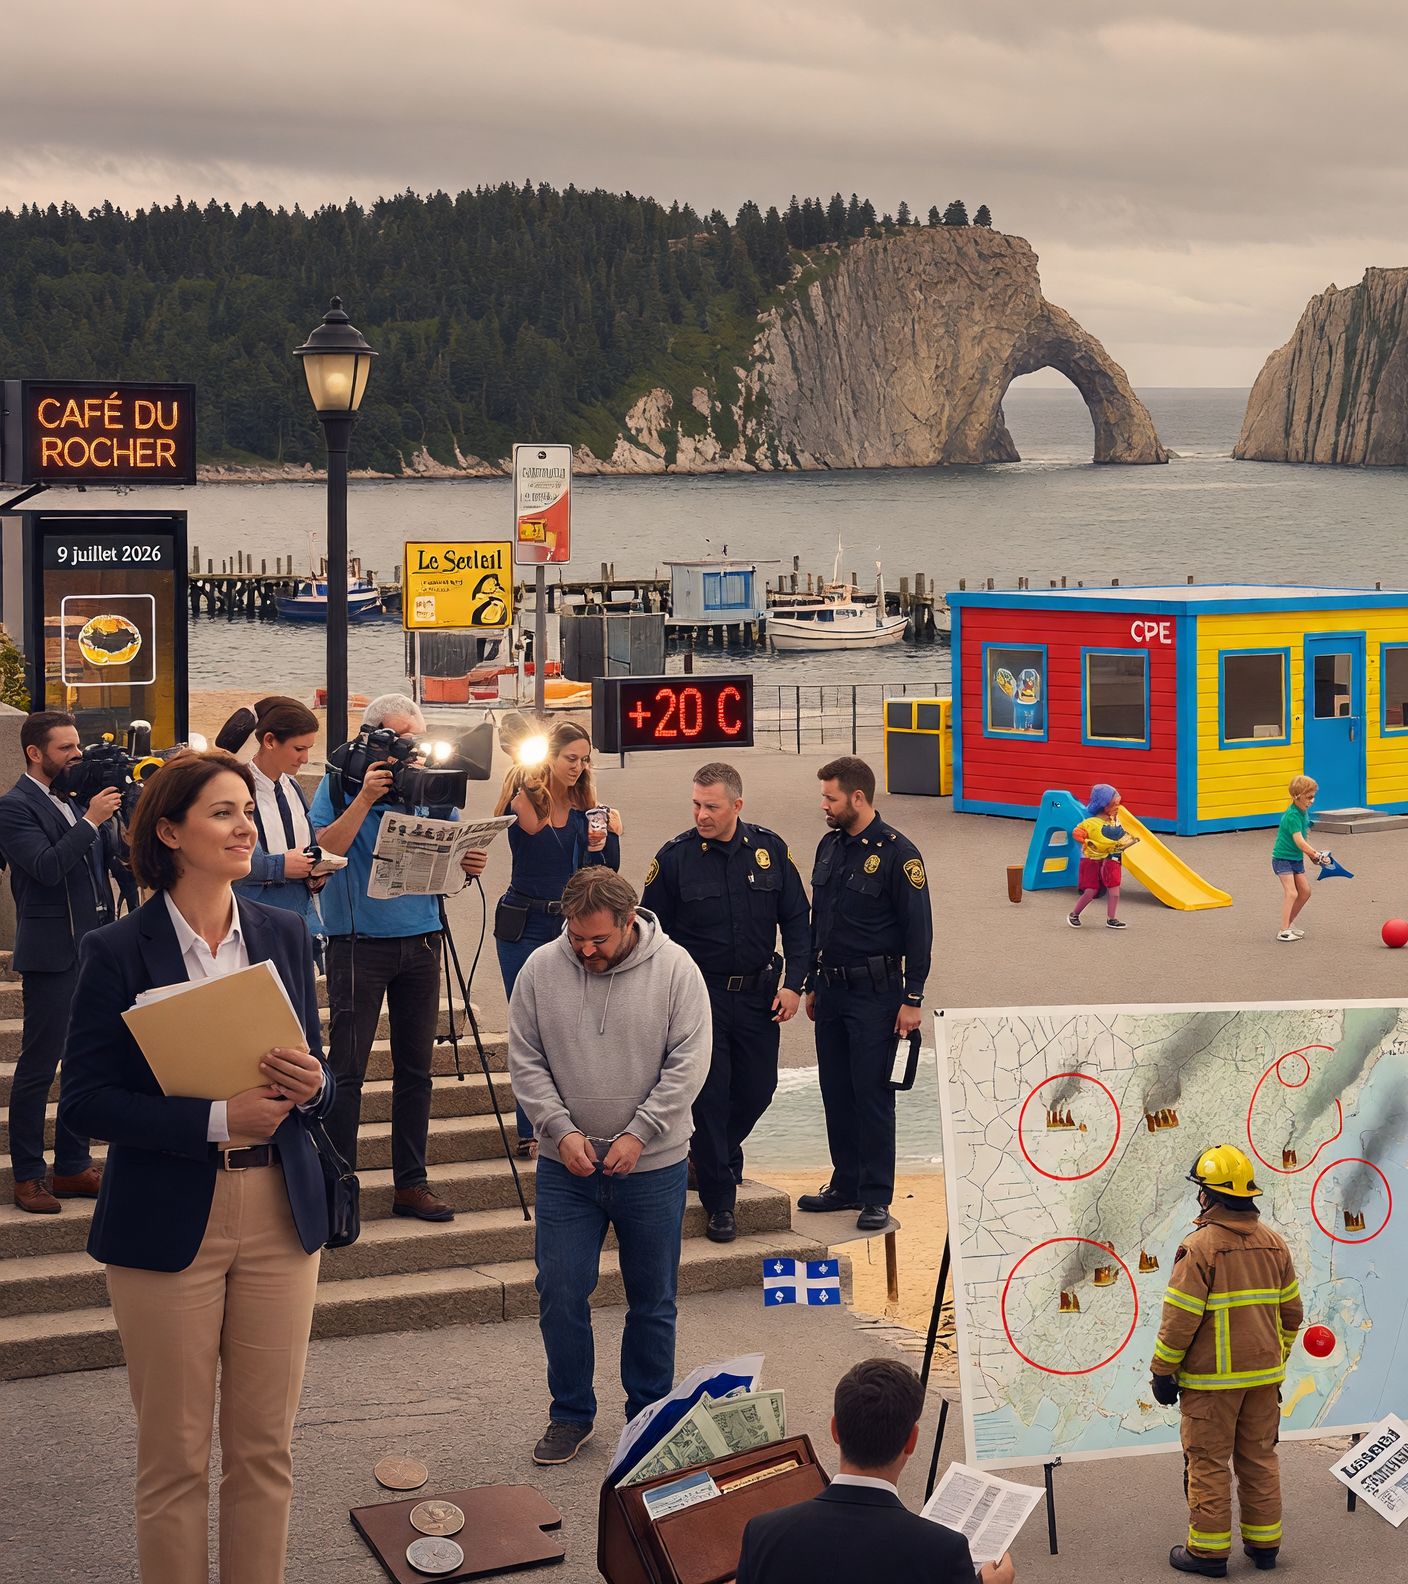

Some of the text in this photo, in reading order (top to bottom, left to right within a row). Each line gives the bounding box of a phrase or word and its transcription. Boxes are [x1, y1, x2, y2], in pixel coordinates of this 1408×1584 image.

[38, 392, 178, 430] CAFÉ DU
[42, 437, 176, 467] ROCHER
[57, 545, 162, 565] 9 juillet 2026
[419, 550, 439, 569] Le
[1131, 621, 1171, 644] CPE
[629, 687, 742, 737] +20 C
